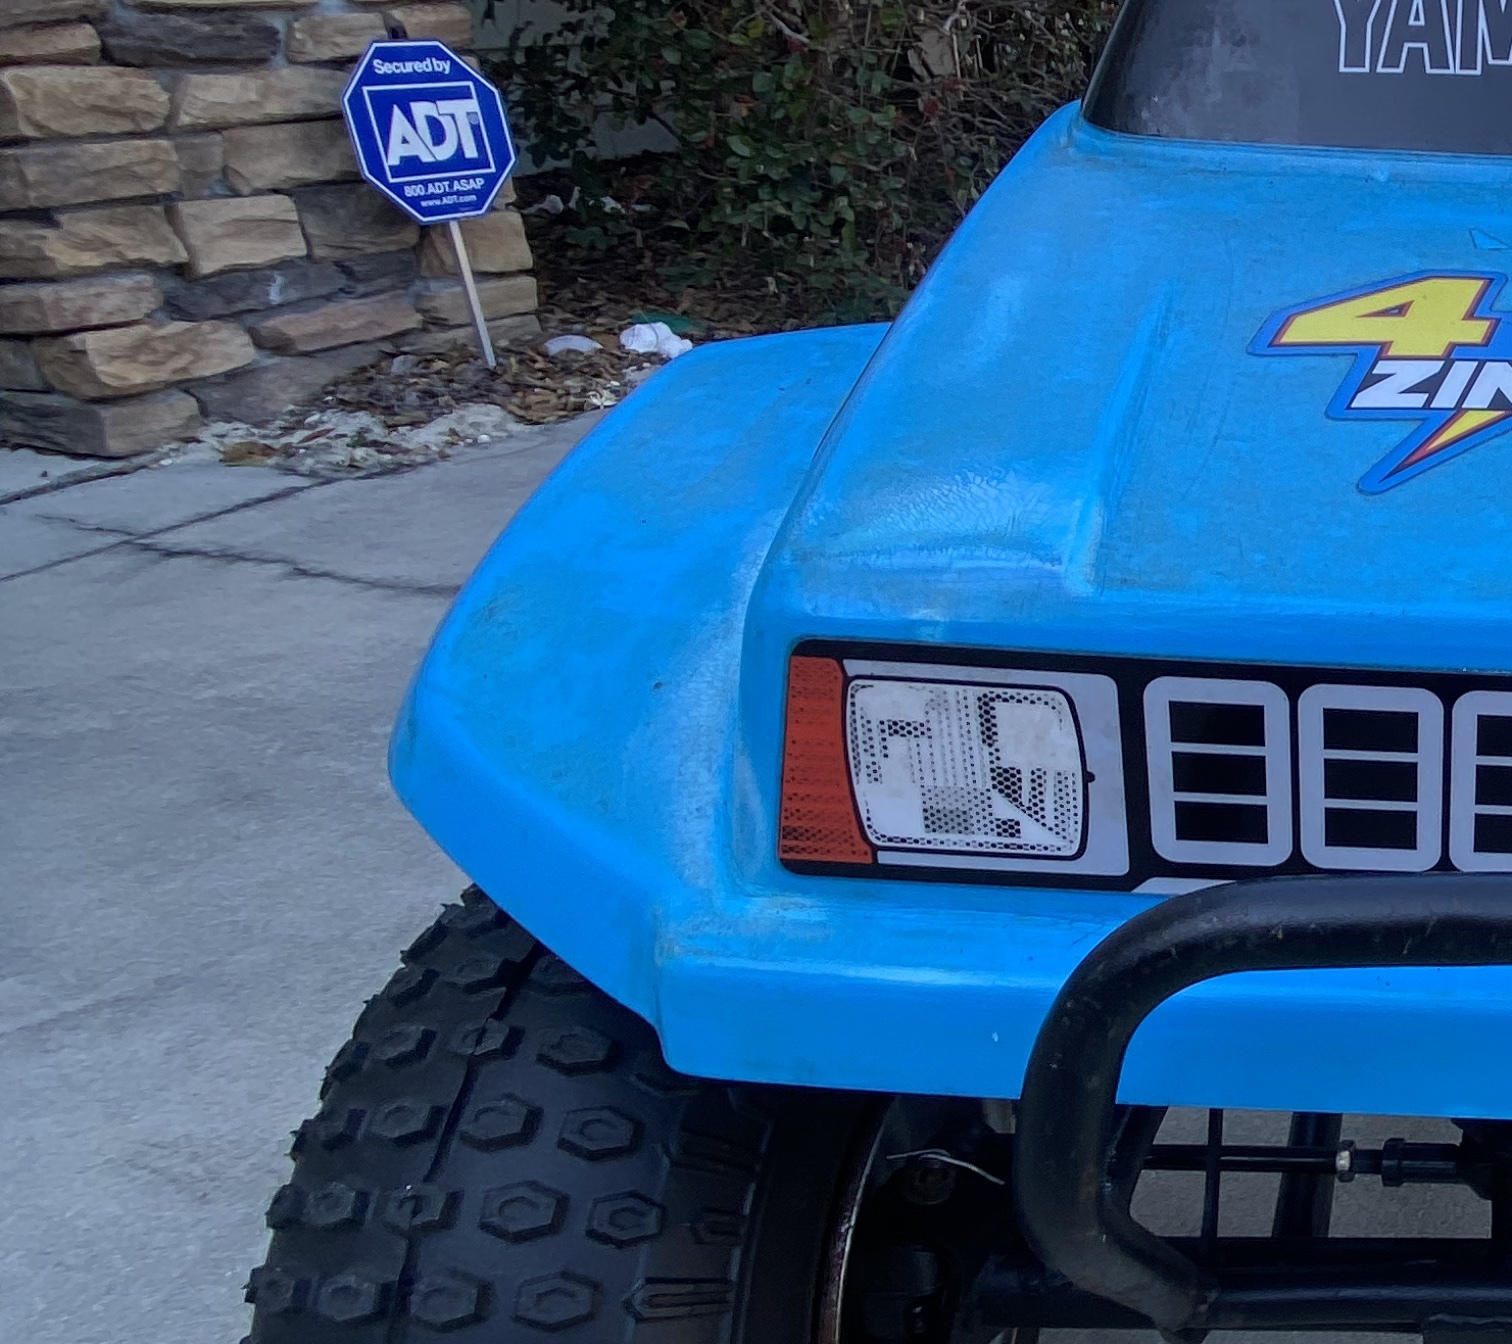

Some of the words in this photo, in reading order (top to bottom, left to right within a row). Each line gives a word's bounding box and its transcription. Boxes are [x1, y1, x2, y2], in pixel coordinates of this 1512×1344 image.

[373, 57, 432, 74] Secured
[432, 57, 450, 74] by
[387, 97, 479, 166] ADT
